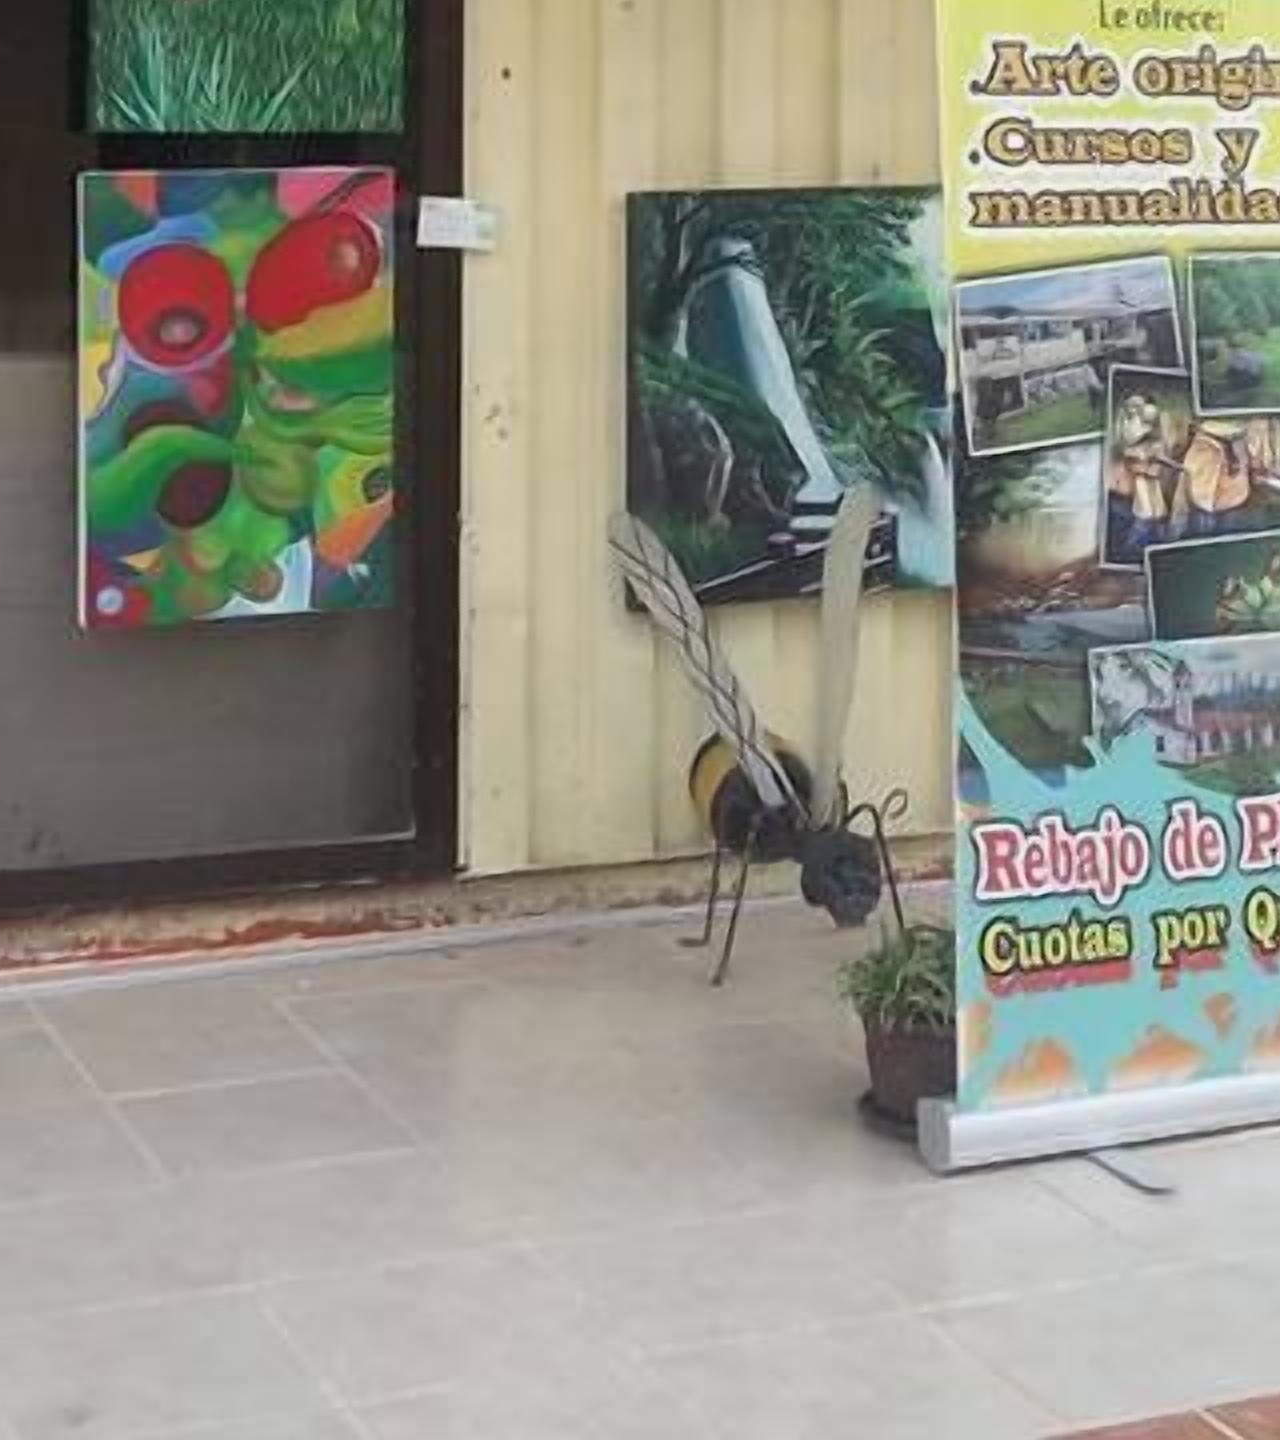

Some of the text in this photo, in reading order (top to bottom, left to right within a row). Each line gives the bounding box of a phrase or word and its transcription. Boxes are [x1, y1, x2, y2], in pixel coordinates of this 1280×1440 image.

[1215, 127, 1260, 178] y
[974, 807, 1150, 910] Rebajo
[1162, 796, 1228, 882] de
[981, 909, 1132, 974] Cuotas
[1152, 903, 1228, 968] por
